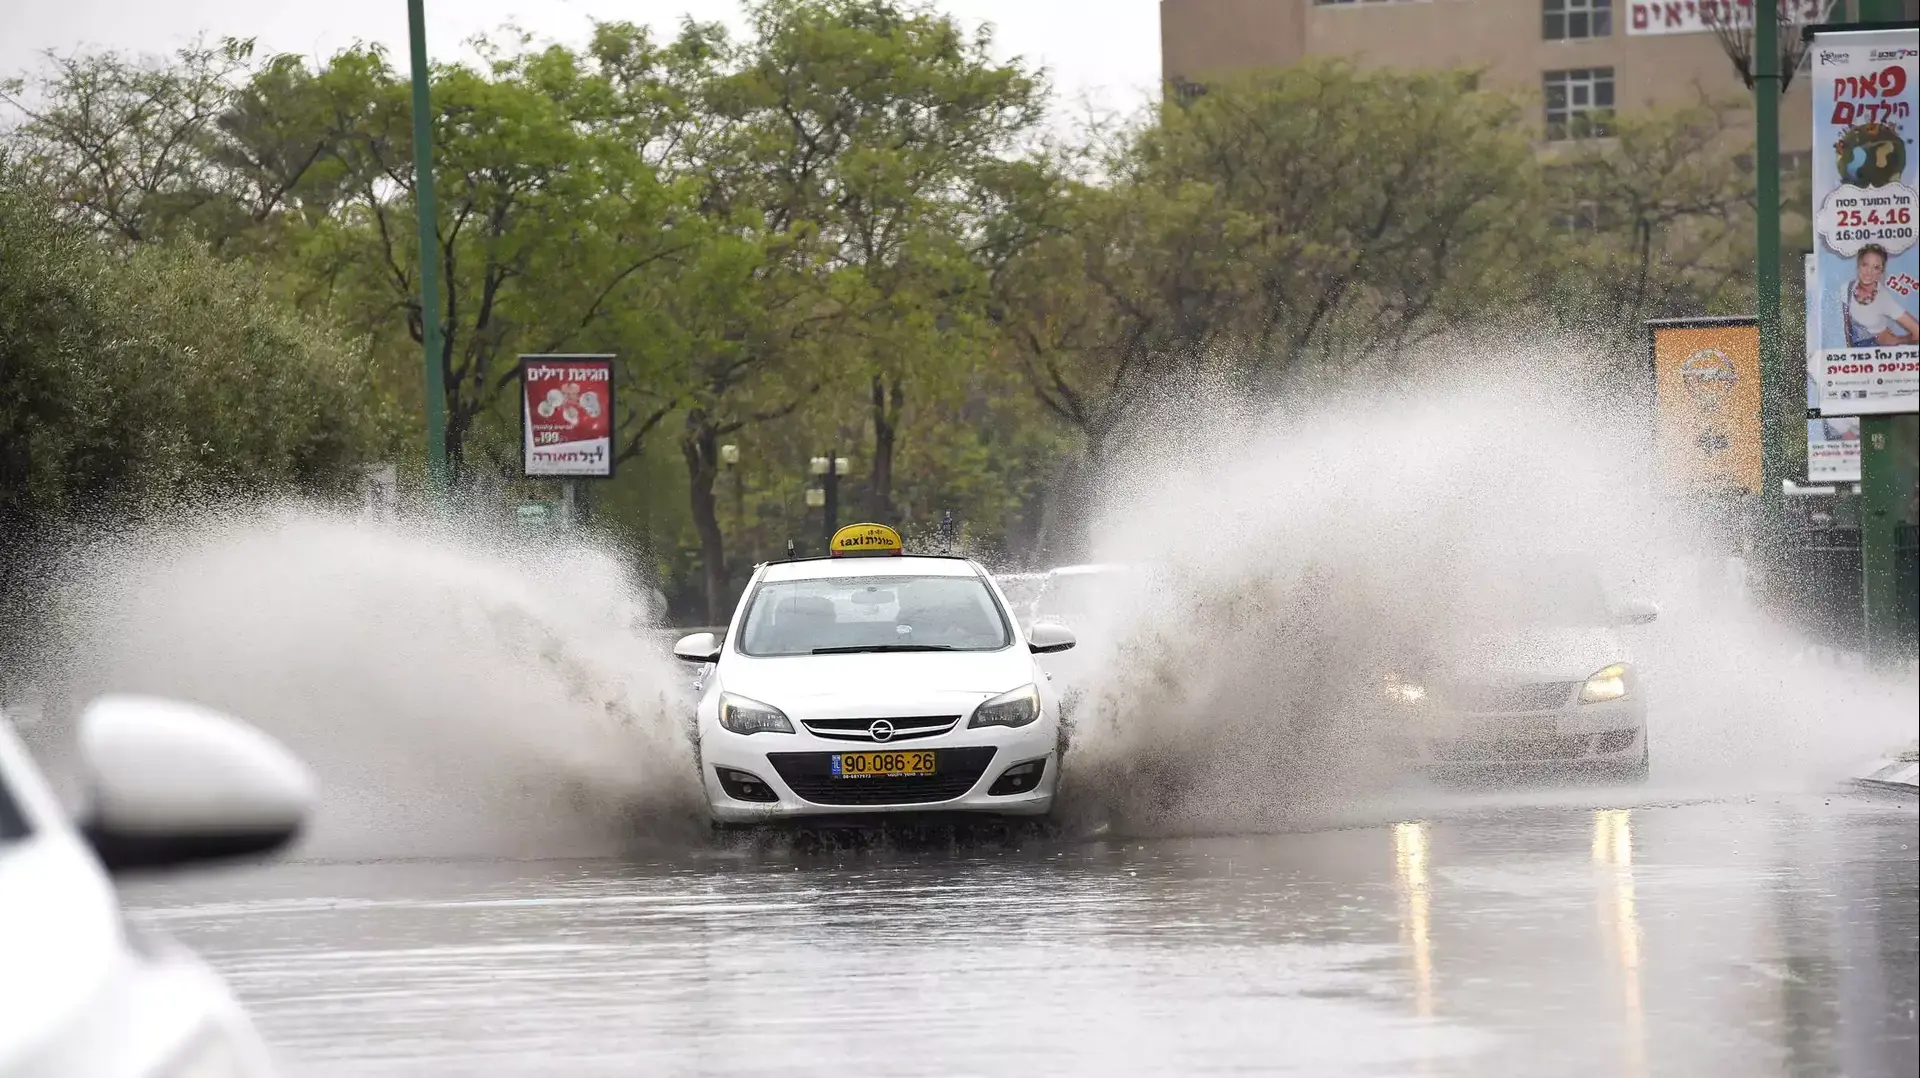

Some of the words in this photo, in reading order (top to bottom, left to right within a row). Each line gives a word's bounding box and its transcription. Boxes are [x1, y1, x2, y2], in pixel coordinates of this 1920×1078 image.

[1834, 65, 1907, 101] פארק
[1831, 99, 1909, 124] הילדים
[1836, 199, 1857, 207] פסח
[1860, 196, 1891, 206] המועד
[1893, 194, 1910, 205] חול
[1837, 207, 1911, 227] 25.4.16
[1836, 227, 1912, 241] 16:00-10:00
[1875, 349, 1892, 360] נחל
[1896, 351, 1920, 361] ארק
[527, 365, 565, 381] דילים
[568, 367, 609, 381] חגיגת
[1827, 364, 1874, 375] חופשית
[840, 534, 864, 547] taxi
[865, 536, 894, 545] מונית
